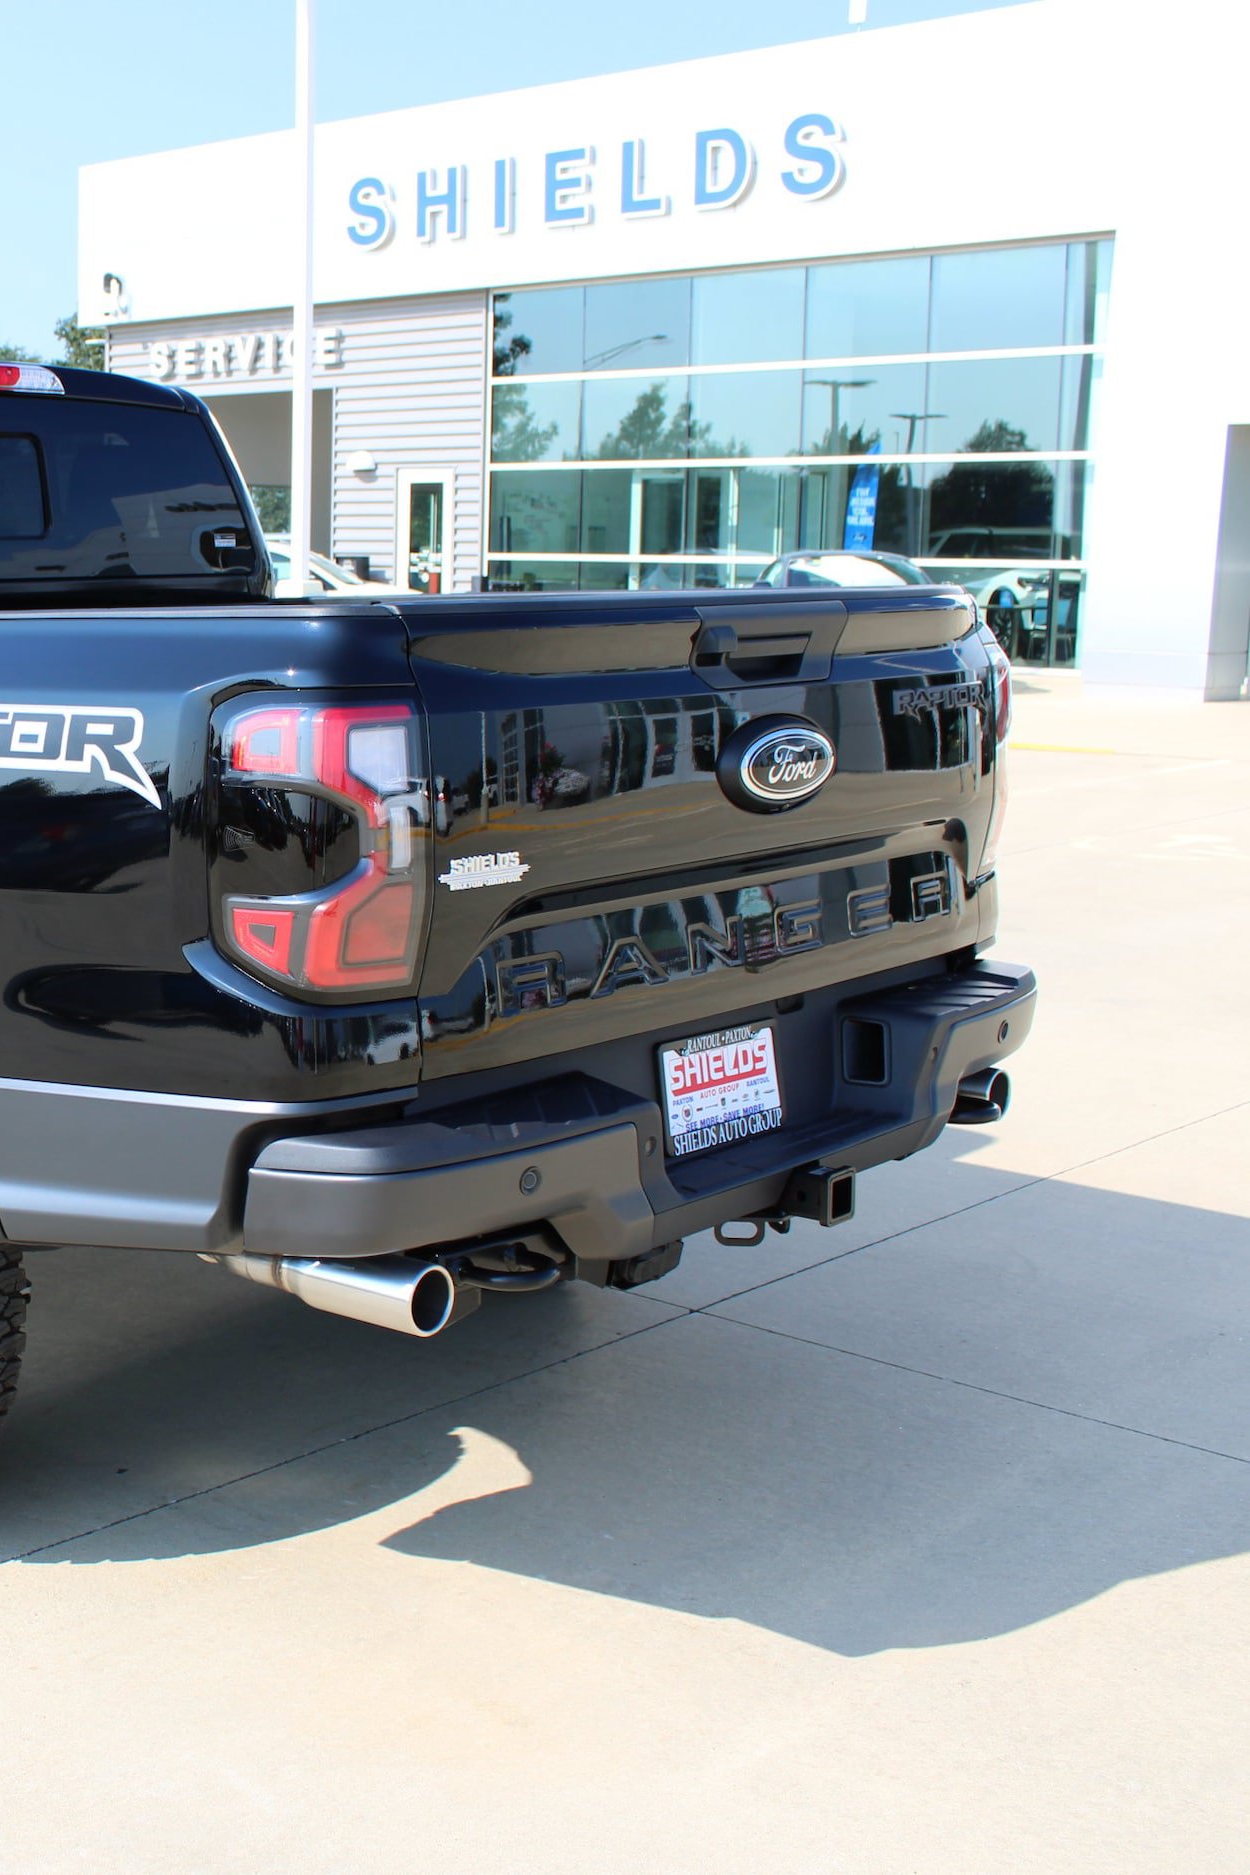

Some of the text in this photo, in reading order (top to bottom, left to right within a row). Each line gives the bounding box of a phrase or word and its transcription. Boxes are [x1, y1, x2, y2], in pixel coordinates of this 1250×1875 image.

[348, 113, 847, 252] SHIELDS
[893, 681, 988, 725] RAPTOR
[768, 744, 817, 784] Ford
[450, 851, 520, 874] SHIELDS
[495, 869, 952, 1018] RANGER
[725, 1026, 751, 1044] PAXTON
[669, 1038, 768, 1094] SHIELDS
[700, 1083, 740, 1099] AUTO GROUP
[674, 1107, 782, 1156] SHIELDS AUTO GROUP
